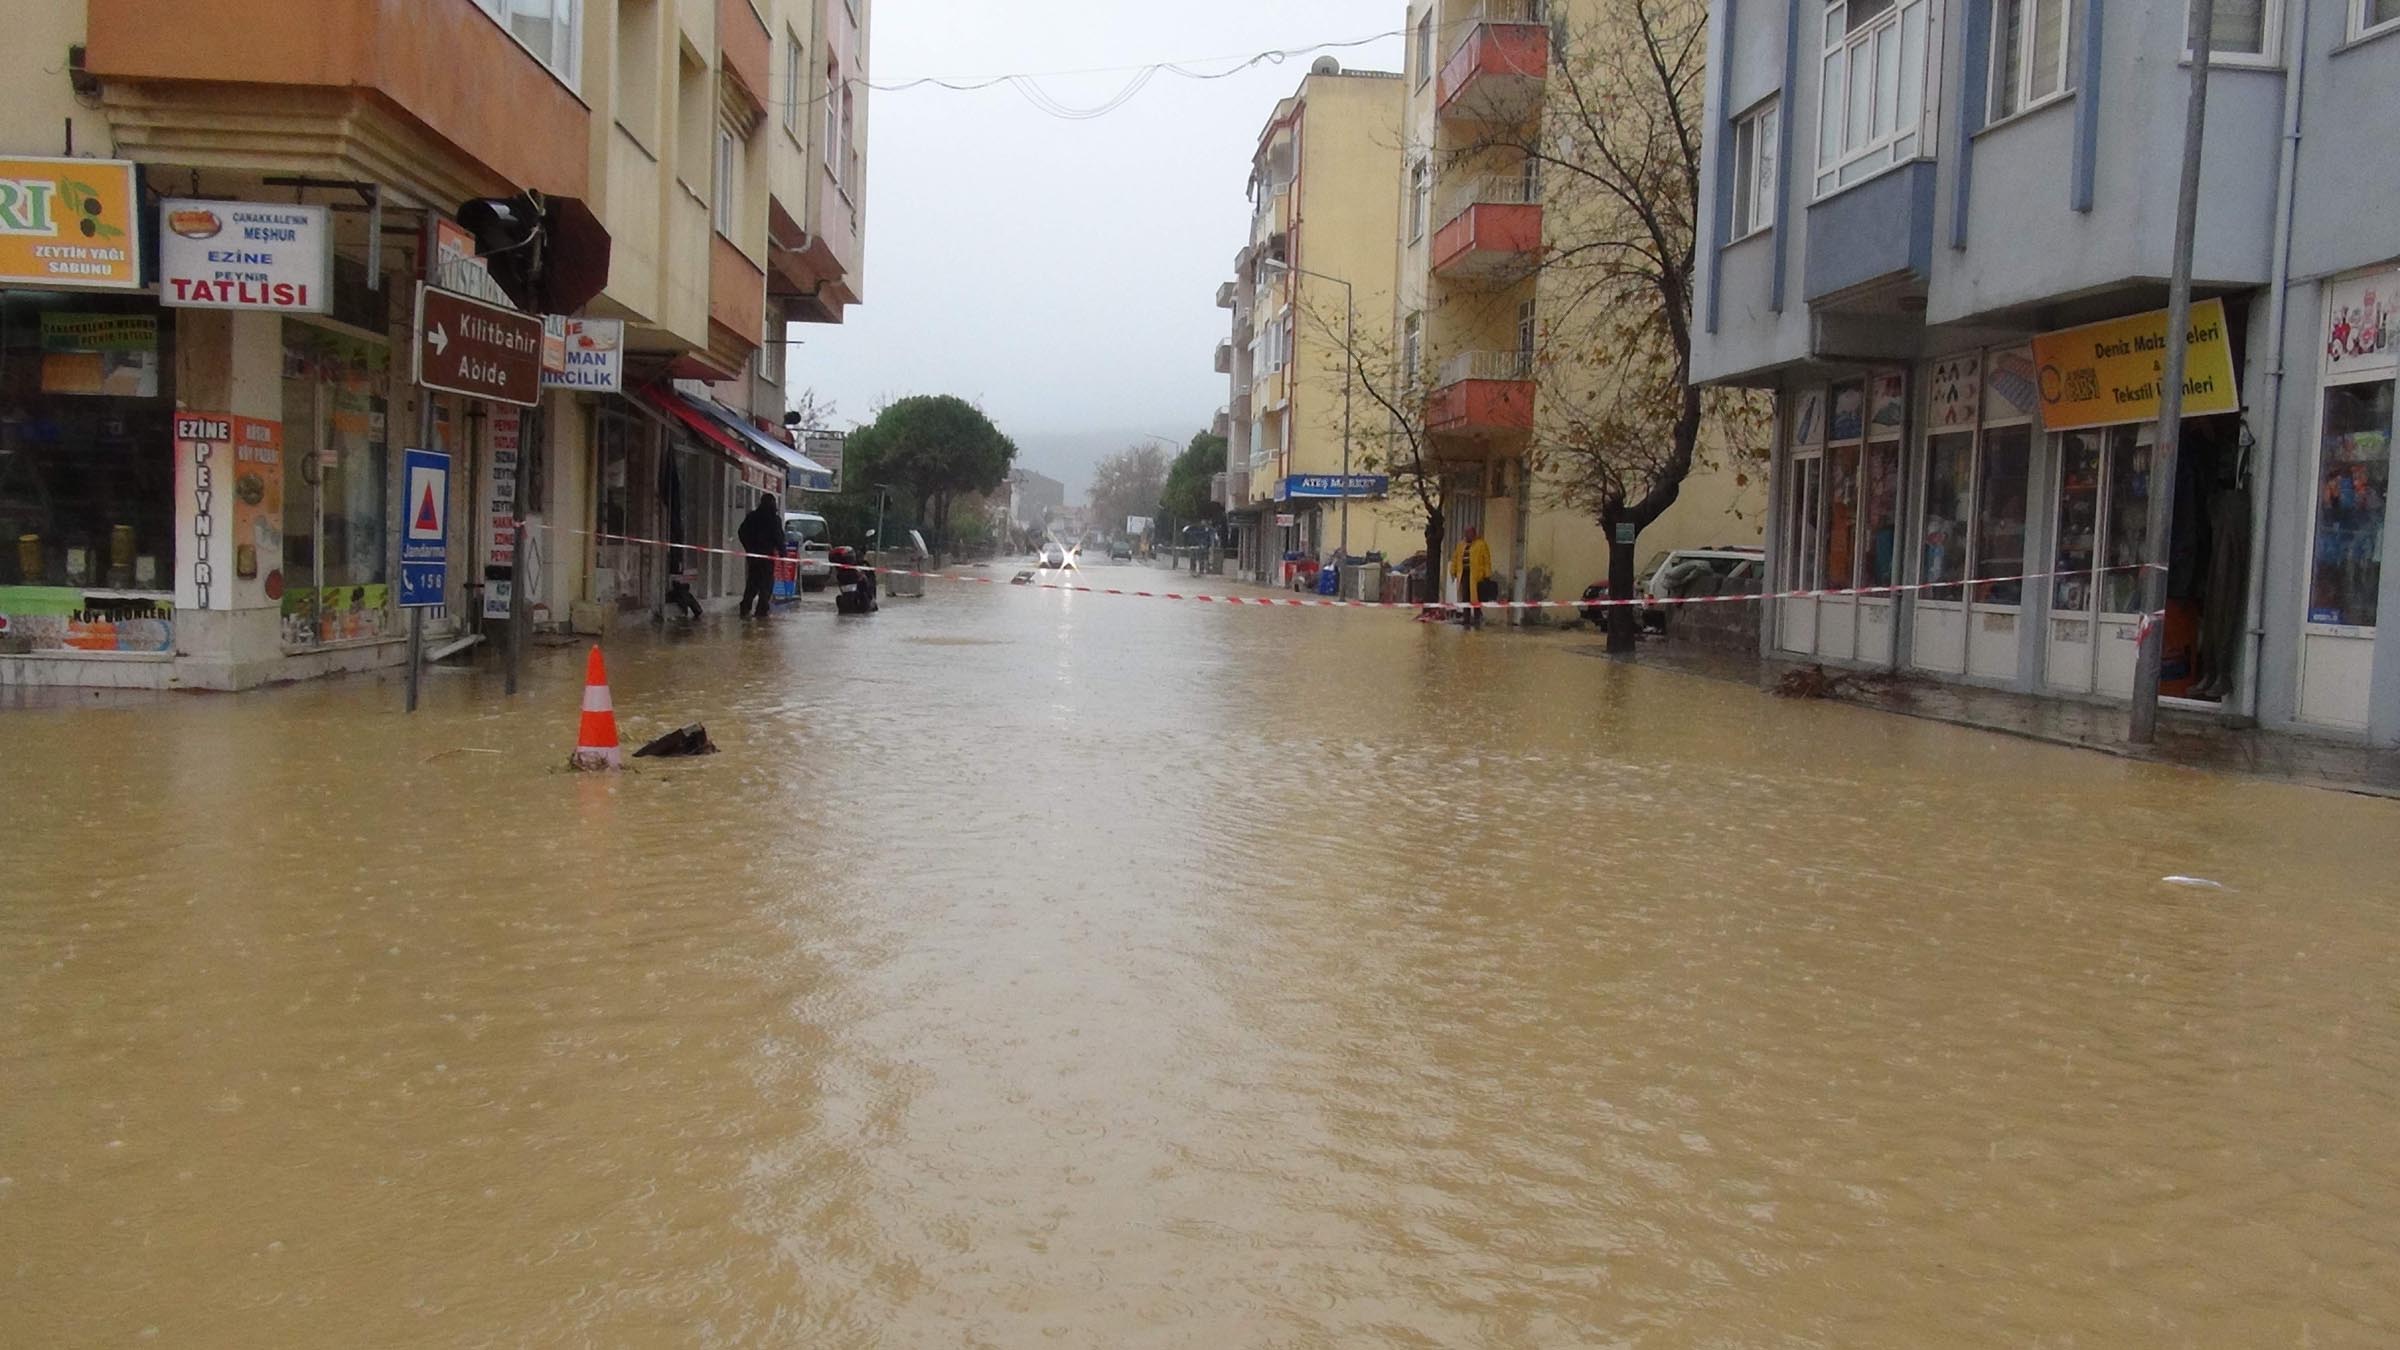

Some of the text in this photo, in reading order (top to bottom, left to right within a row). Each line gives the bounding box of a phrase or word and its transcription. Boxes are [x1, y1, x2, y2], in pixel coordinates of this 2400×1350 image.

[244, 227, 296, 243] MEŞHUR
[35, 245, 125, 261] ZEYTİN YAĞI
[208, 249, 273, 265] EZİNE
[48, 261, 112, 275] SABUNU
[214, 271, 269, 281] PEYNİR
[170, 278, 308, 306] TATLISI
[460, 313, 536, 354] Kilitbahir
[2095, 322, 2219, 358] Deniz Malzeleri
[458, 355, 506, 386] Abide
[2112, 383, 2152, 403] Tekstil
[2156, 376, 2214, 396] Ünleri
[178, 418, 231, 440] EZİNE
[1302, 478, 1328, 489] ATEŞ
